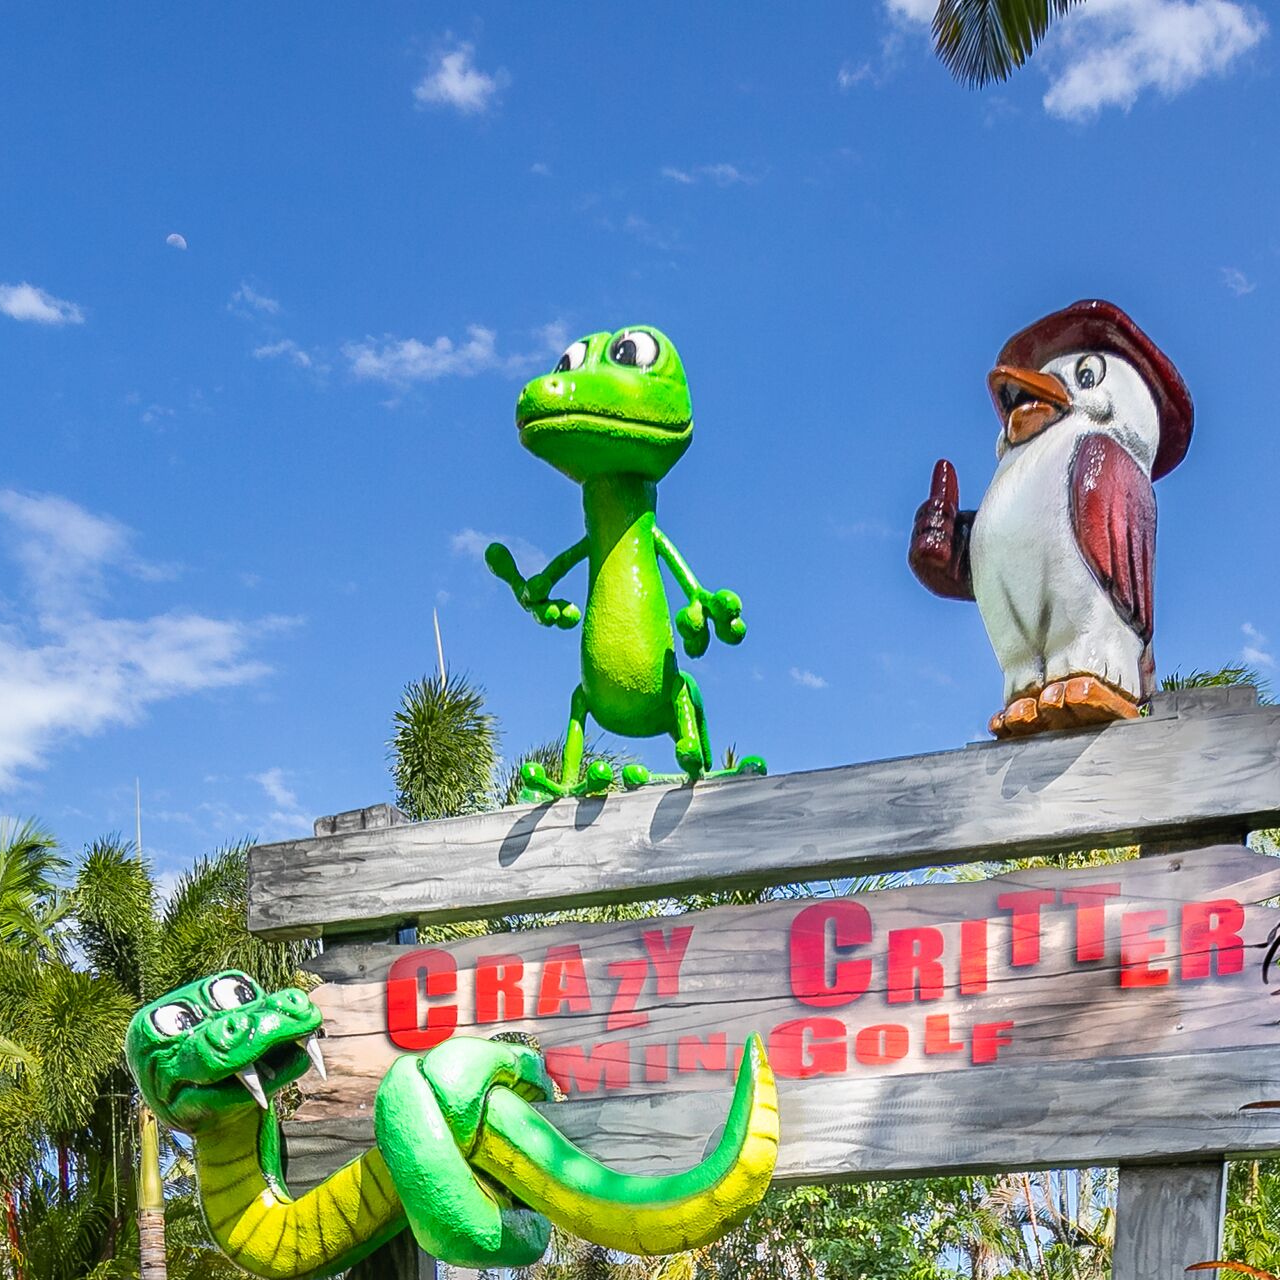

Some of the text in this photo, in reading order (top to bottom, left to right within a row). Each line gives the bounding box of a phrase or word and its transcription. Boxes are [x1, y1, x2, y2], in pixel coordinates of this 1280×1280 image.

[387, 883, 1245, 1050] CRAZY CRITTER
[767, 1014, 1014, 1078] GOLF
